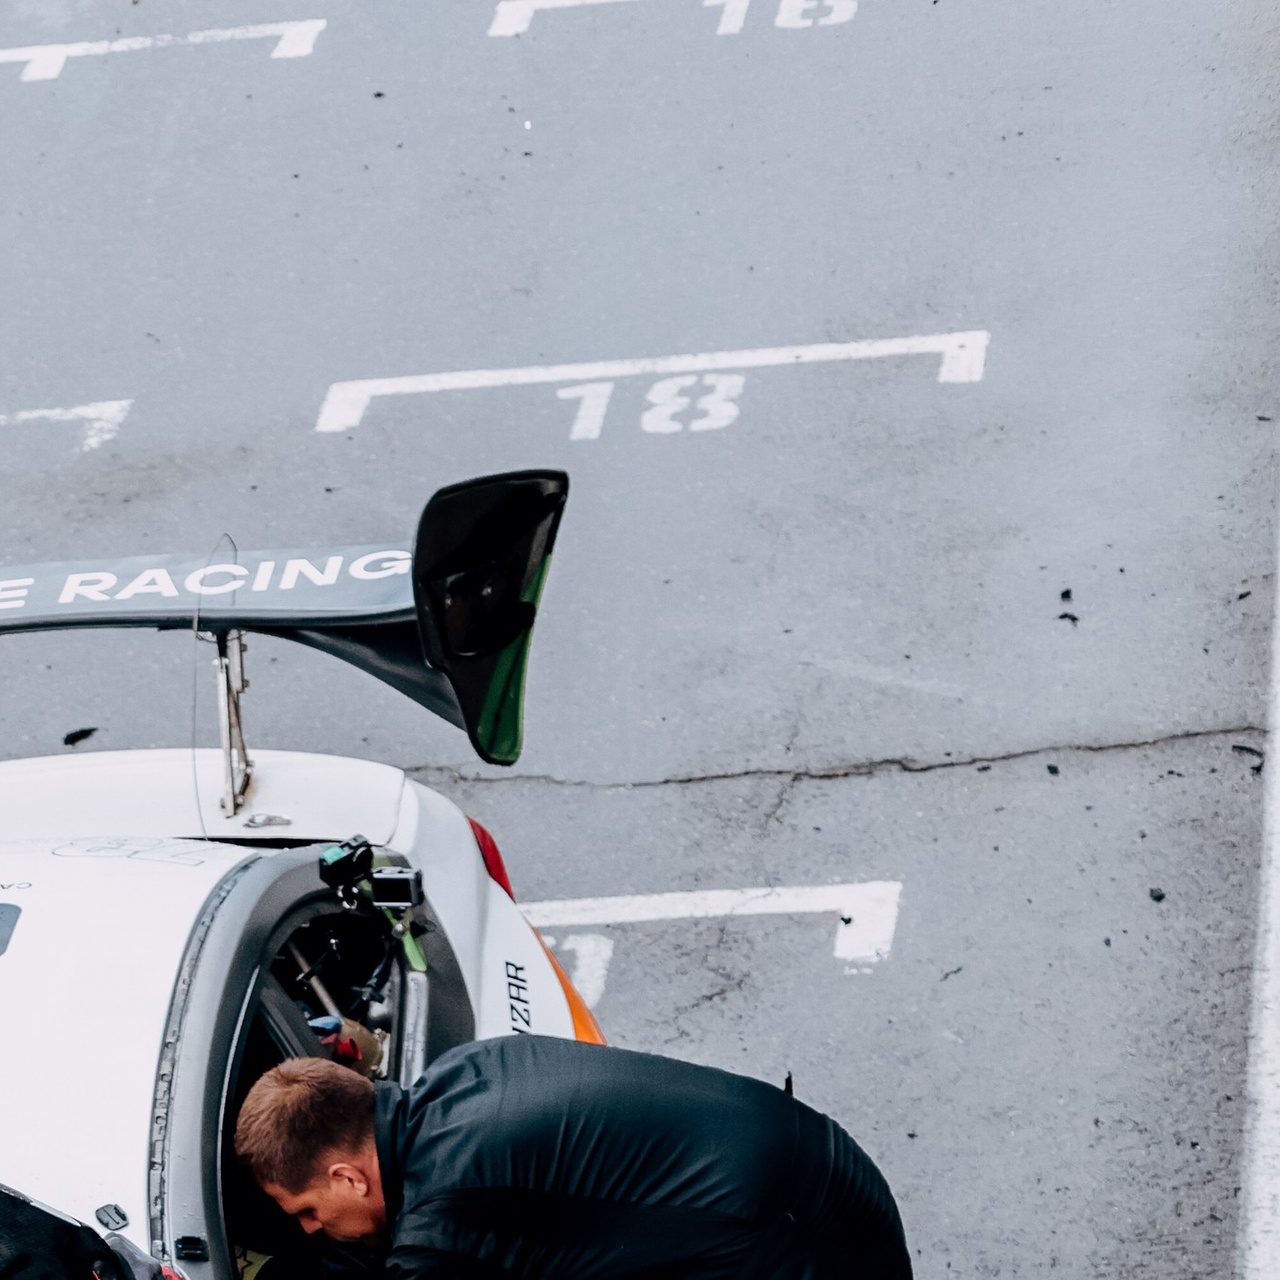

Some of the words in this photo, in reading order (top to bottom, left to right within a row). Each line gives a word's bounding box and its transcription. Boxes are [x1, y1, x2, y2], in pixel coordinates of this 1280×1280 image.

[556, 372, 746, 441] 18
[57, 550, 413, 604] RACING
[505, 960, 532, 1034] ZAR
